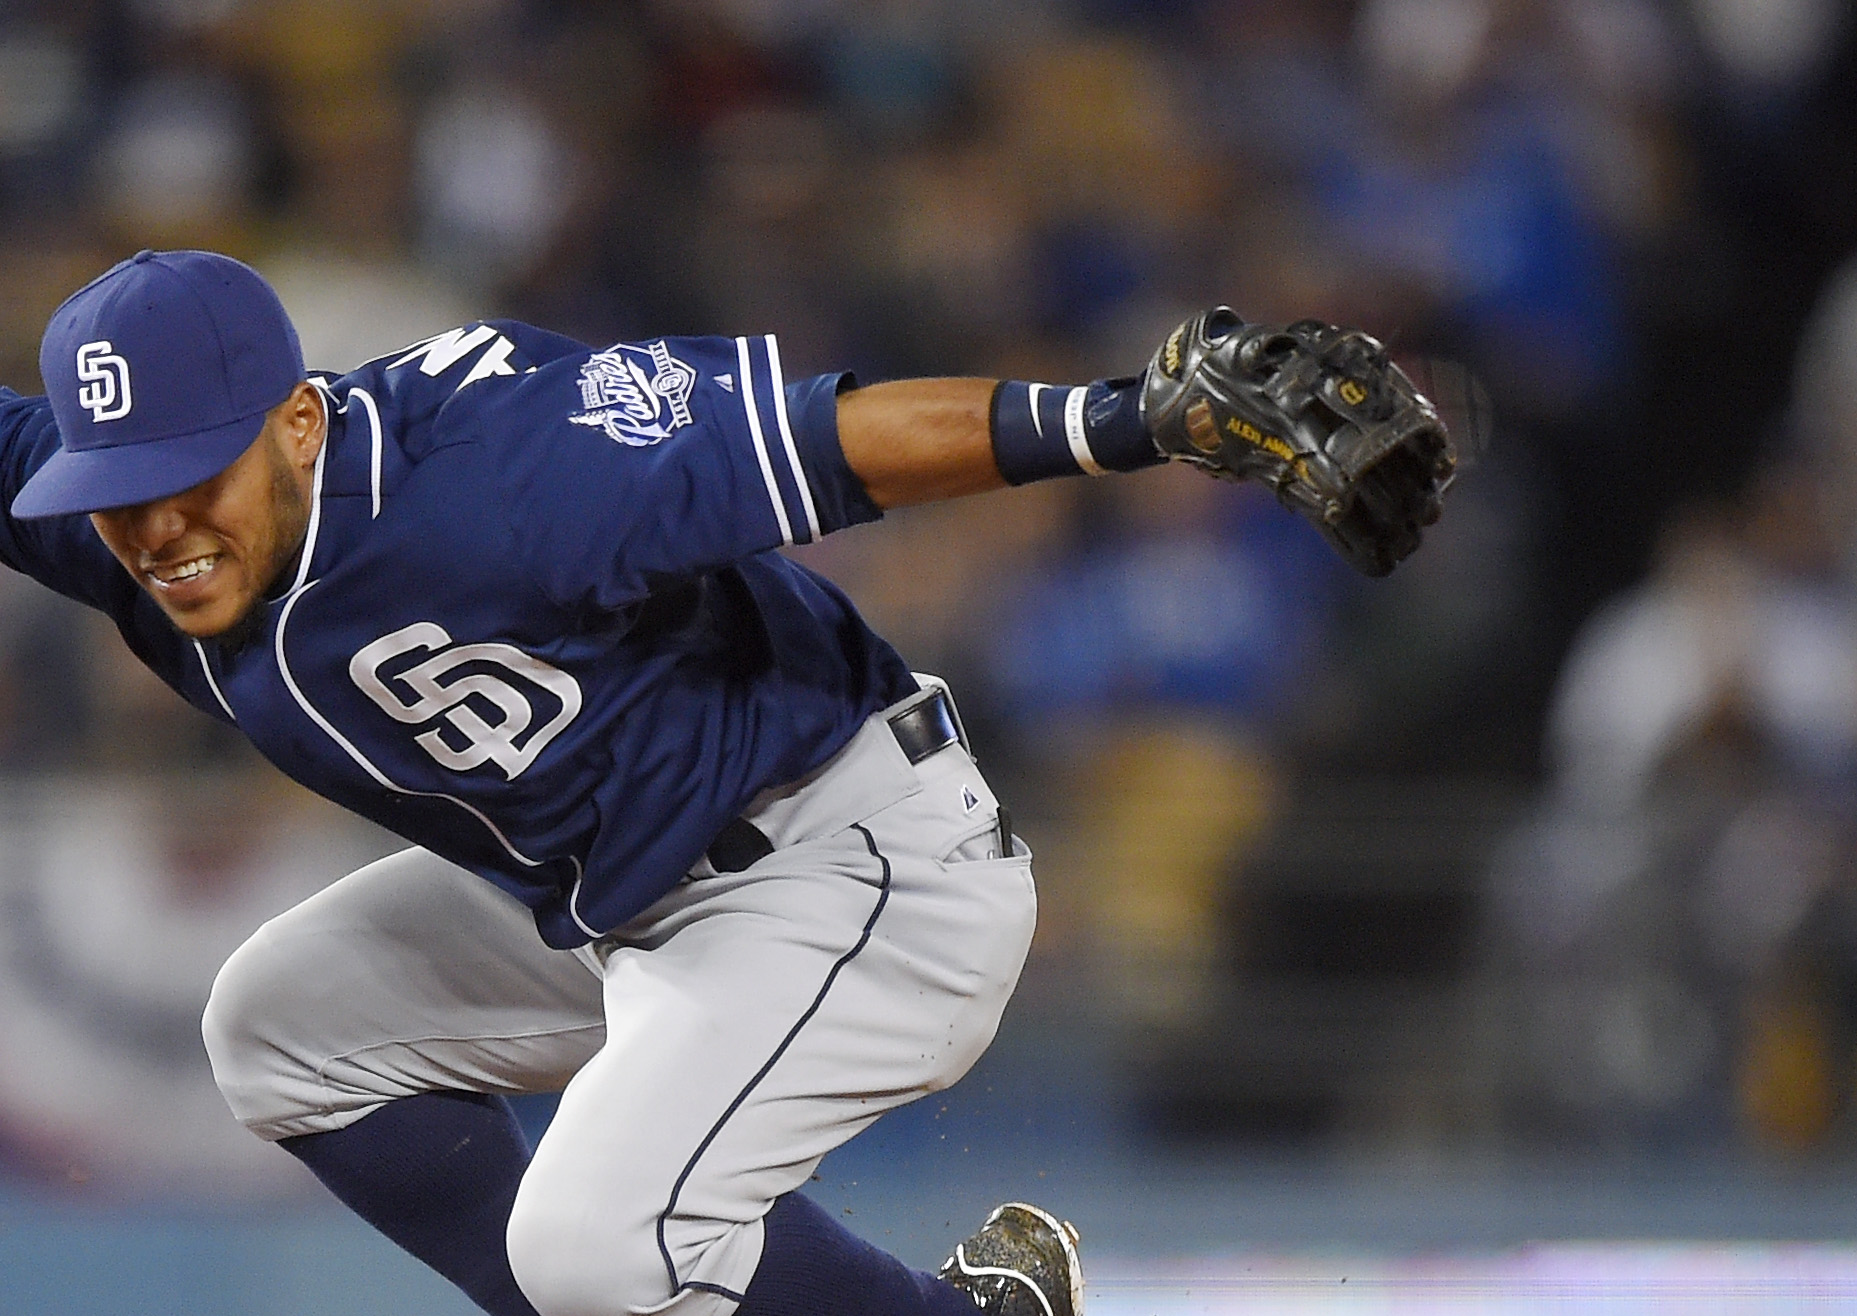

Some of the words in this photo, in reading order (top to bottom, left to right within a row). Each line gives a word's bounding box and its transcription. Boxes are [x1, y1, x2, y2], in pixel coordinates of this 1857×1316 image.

[77, 341, 132, 423] SD
[590, 352, 672, 446] Padres
[349, 622, 582, 781] SD
